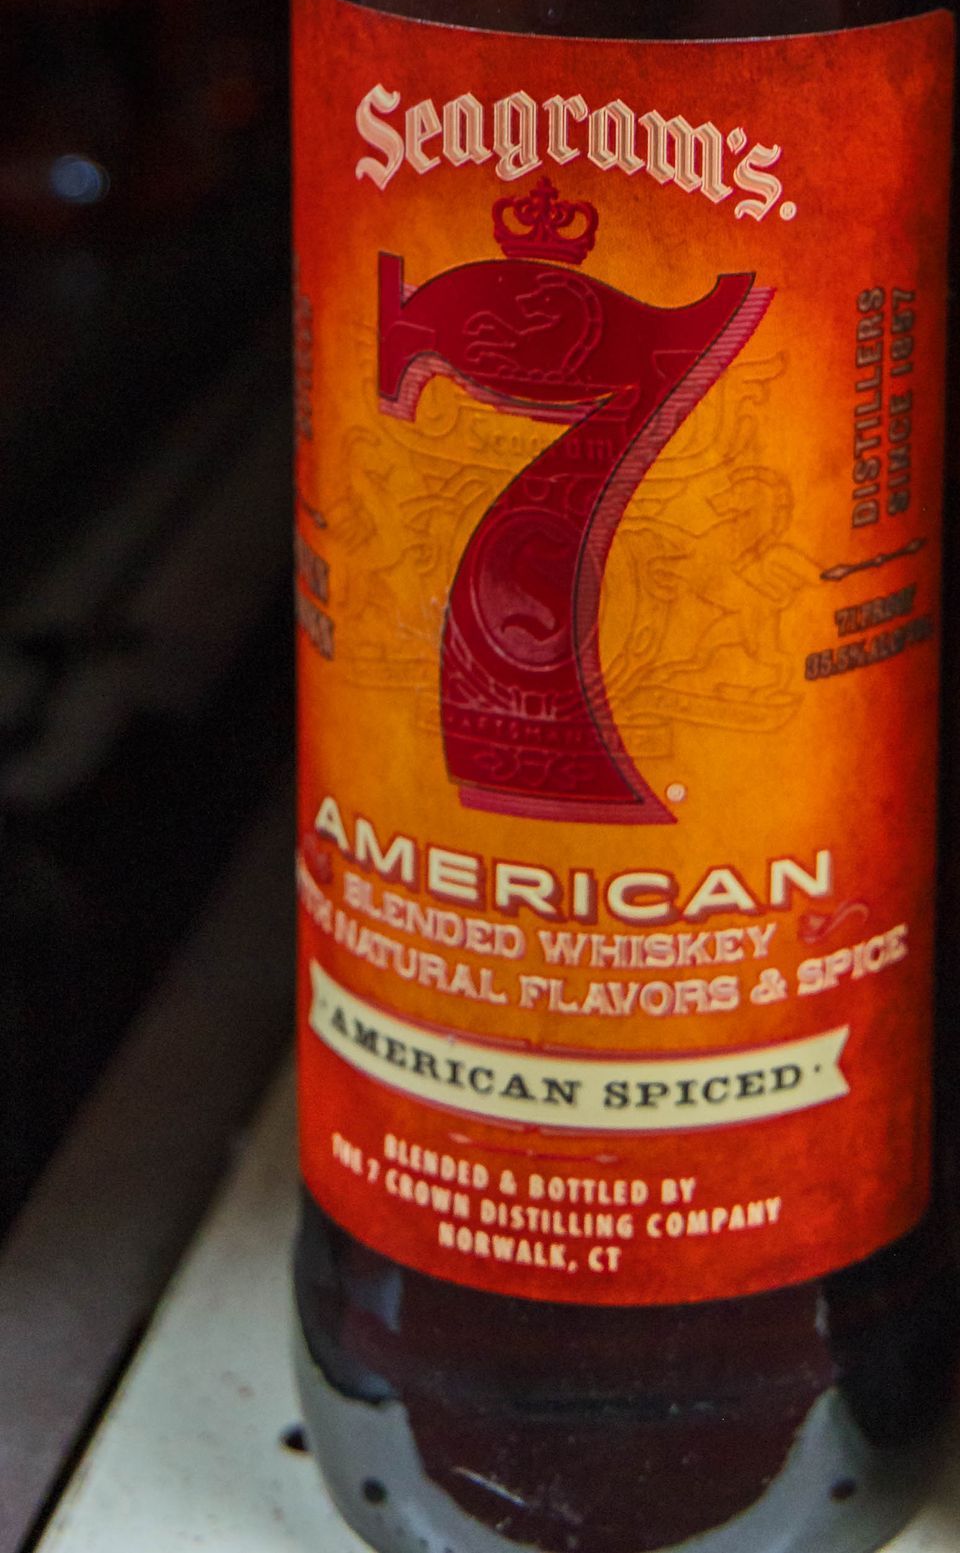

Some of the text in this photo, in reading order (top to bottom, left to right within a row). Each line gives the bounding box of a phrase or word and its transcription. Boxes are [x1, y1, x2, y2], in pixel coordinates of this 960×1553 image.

[851, 286, 885, 529] DISTILLERS
[377, 251, 774, 824] 7
[313, 795, 832, 921] AMERICAN
[343, 871, 776, 969] BLENDED WHISKEY
[519, 972, 740, 1017] FLAVORS
[750, 967, 788, 1005] &
[797, 922, 909, 995] SPICE
[329, 1007, 803, 1109] AMERICAN SPICED
[367, 1157, 381, 1184] 7
[385, 1168, 471, 1220] CROWN
[480, 1198, 634, 1240] DISTILLING
[646, 1195, 782, 1238] COMPANY
[384, 1133, 697, 1206] BLENDED & BOTTLED BY
[588, 1245, 622, 1273] CT
